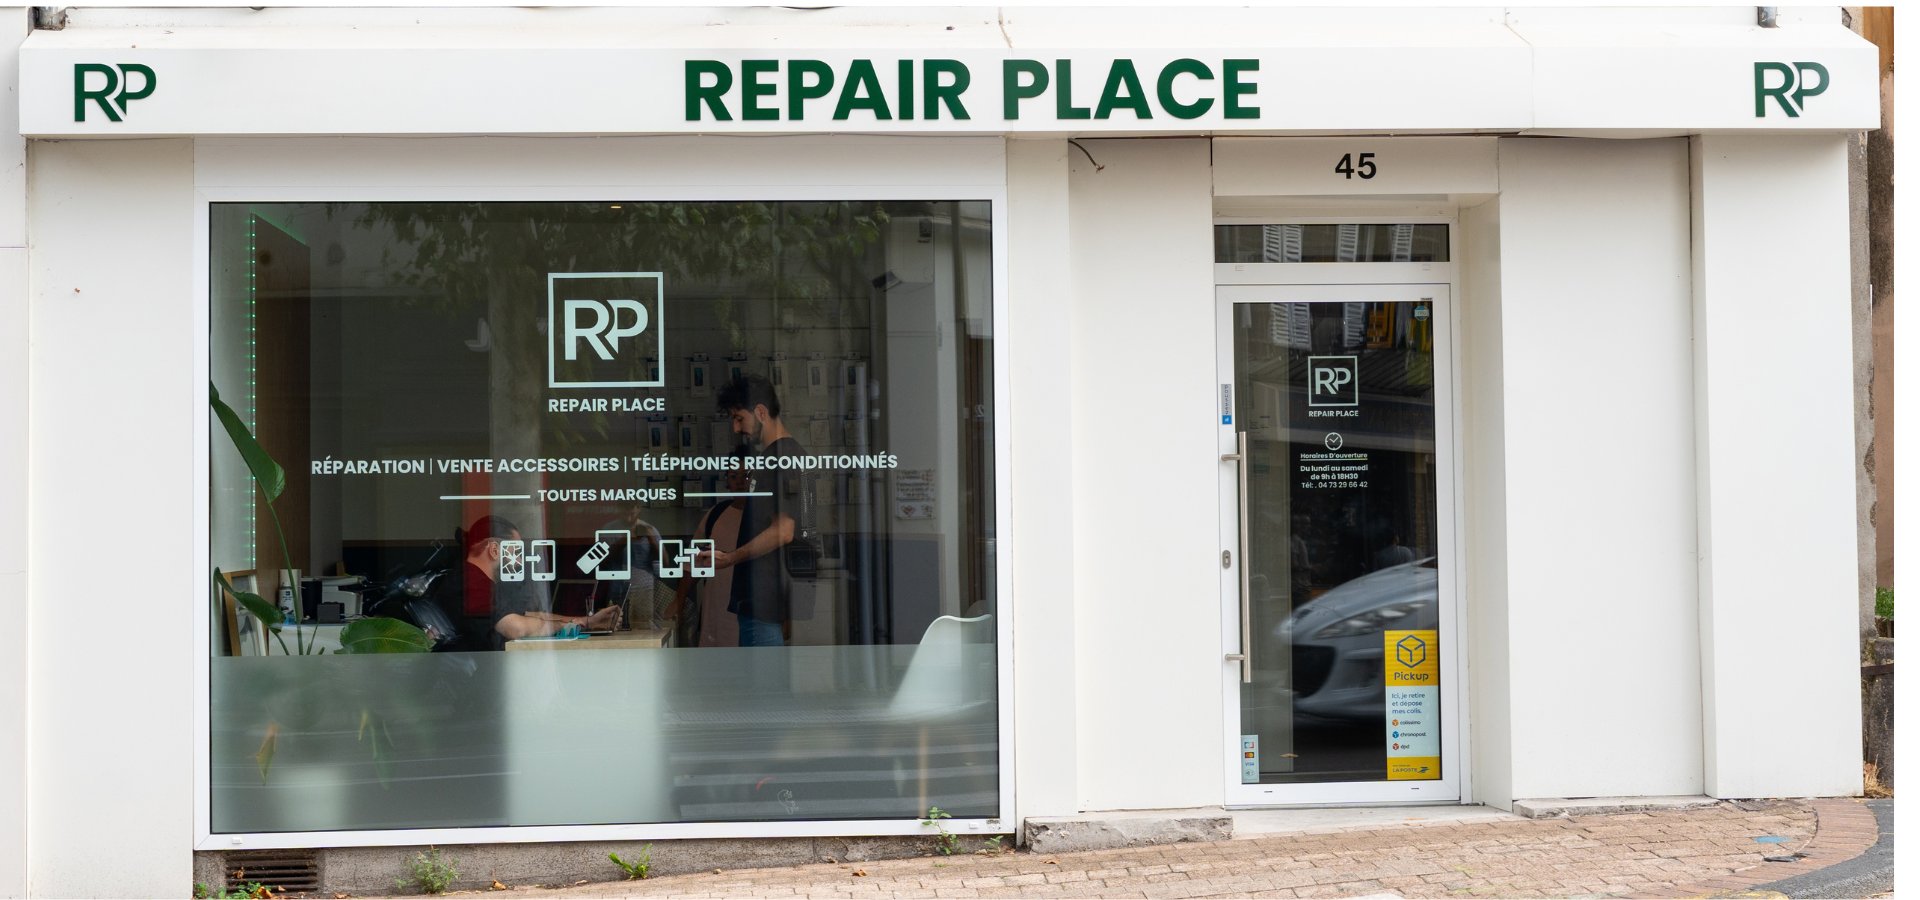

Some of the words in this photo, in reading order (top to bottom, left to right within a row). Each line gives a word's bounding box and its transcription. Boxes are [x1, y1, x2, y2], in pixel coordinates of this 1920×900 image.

[73, 63, 157, 122] RP
[684, 58, 971, 121] REPAIR
[1002, 58, 1261, 120] PLACE
[1754, 61, 1830, 118] RP
[1334, 152, 1377, 180] 45
[564, 299, 649, 361] RP
[1315, 367, 1351, 395] RP
[548, 398, 608, 412] REPAIR
[611, 397, 665, 412] PLACE
[311, 455, 425, 475] RÉPARATION
[437, 458, 493, 473] VENTE
[497, 457, 620, 473] ACCESSOIRES
[631, 452, 740, 472] TÉLÉPHONES
[744, 450, 899, 471] RECONDITIONNÉS
[1341, 464, 1368, 472] samedi
[537, 488, 597, 502] TOUTES
[600, 488, 677, 503] MARQUES
[1318, 481, 1328, 489] 04
[1394, 671, 1429, 682] Pickup
[1401, 692, 1407, 700] je
